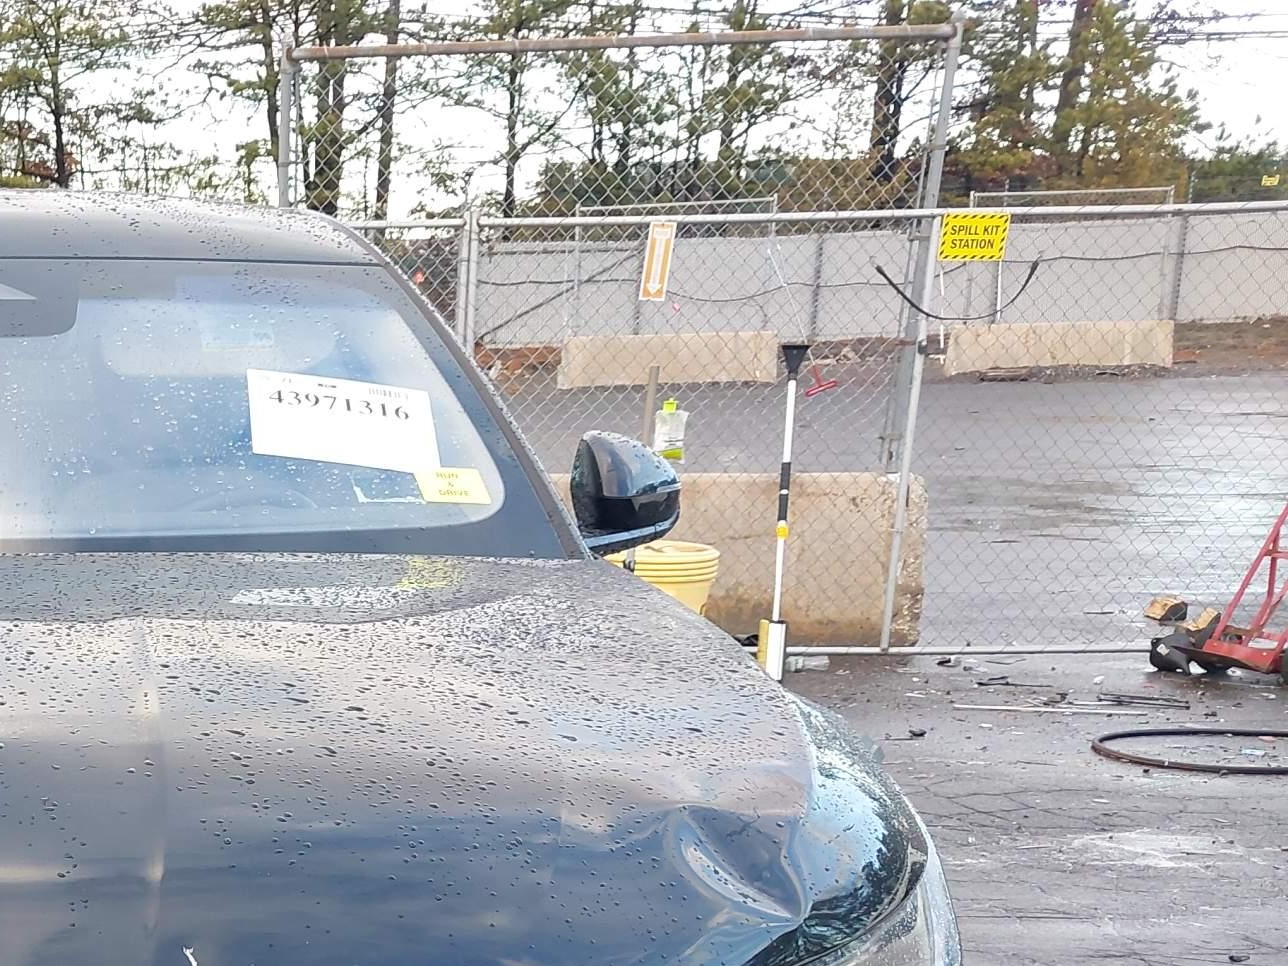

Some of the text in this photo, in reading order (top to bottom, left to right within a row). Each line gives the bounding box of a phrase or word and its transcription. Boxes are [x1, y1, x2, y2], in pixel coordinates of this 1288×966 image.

[950, 224, 1001, 236] SPILL KIT
[950, 238, 995, 249] STATION
[268, 389, 410, 421] 43971316
